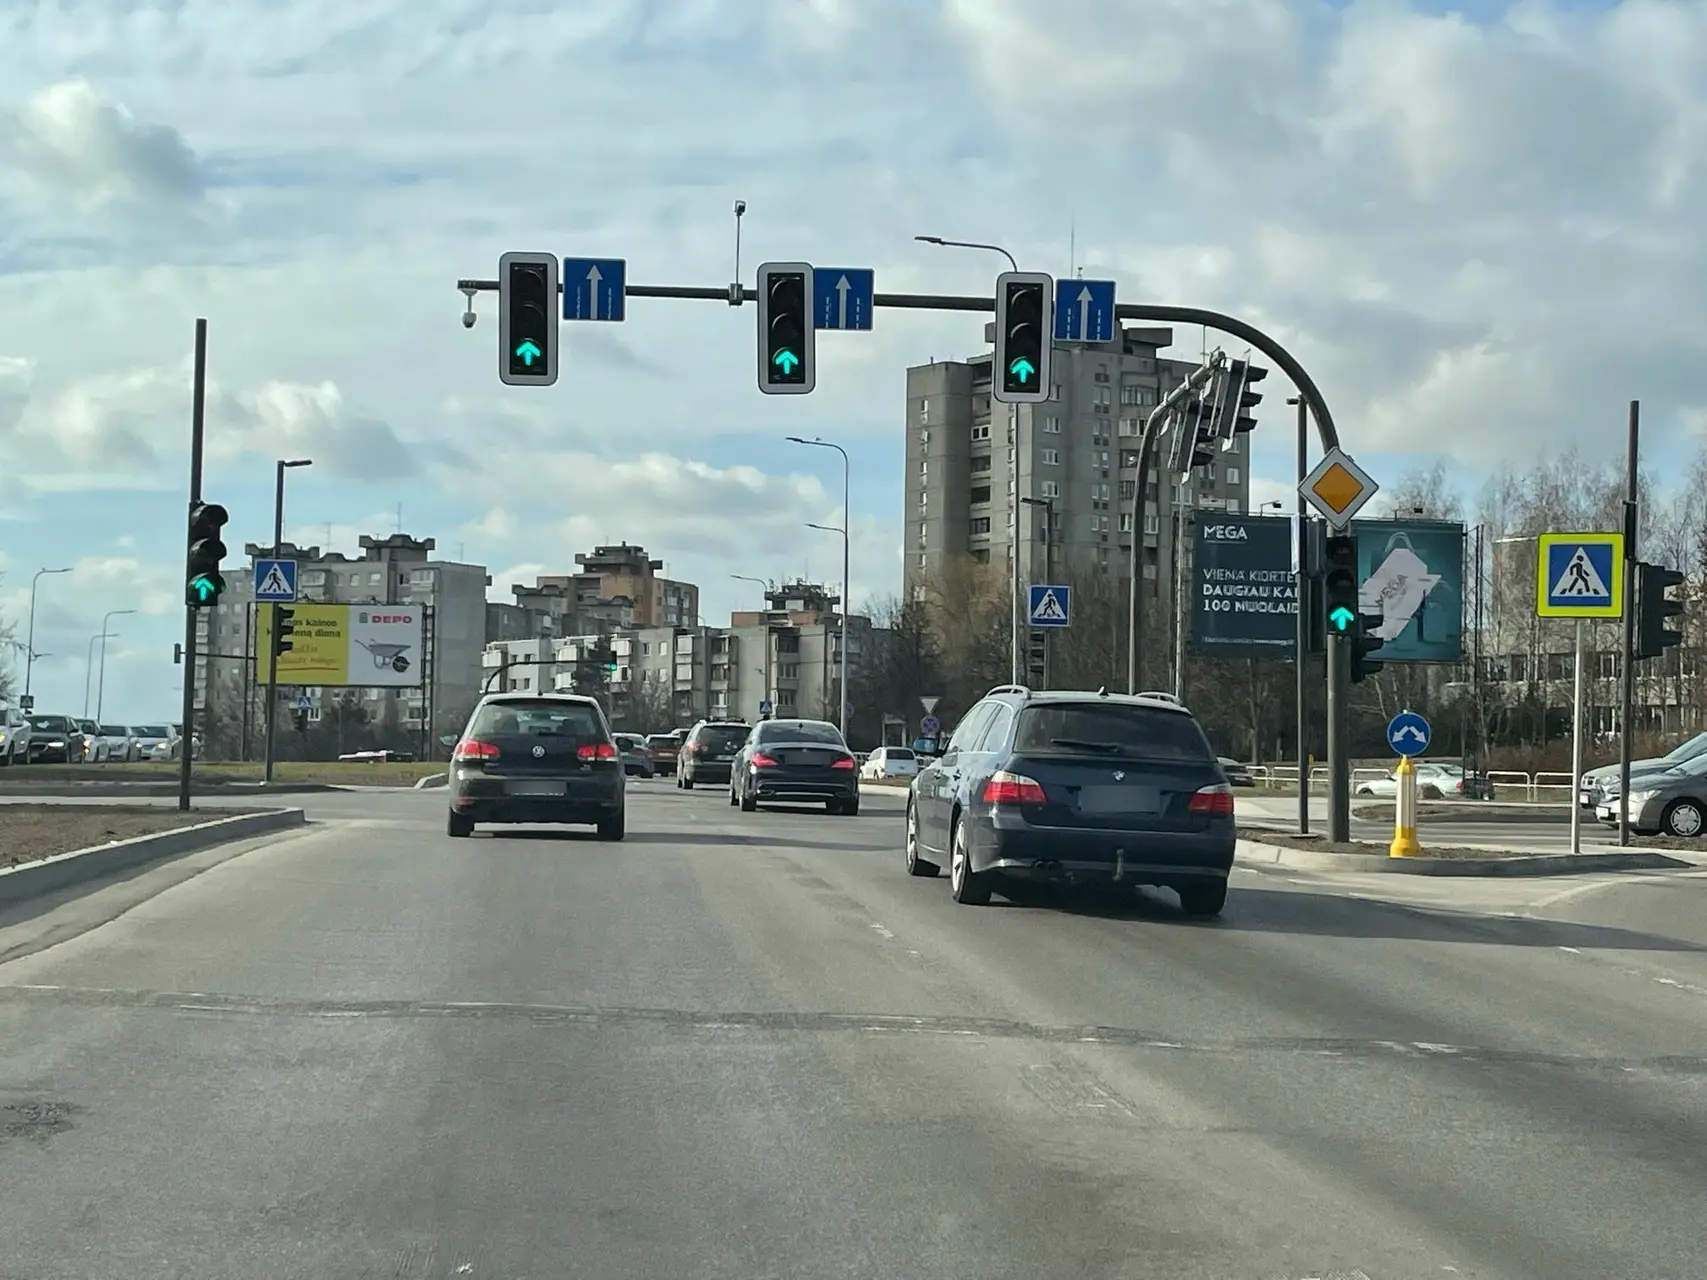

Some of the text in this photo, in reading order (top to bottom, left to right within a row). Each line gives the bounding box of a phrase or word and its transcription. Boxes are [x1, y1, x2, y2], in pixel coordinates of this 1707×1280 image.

[1203, 525, 1248, 540] MEGA
[1203, 568, 1295, 583] VIENA KORTE
[1203, 584, 1271, 598] DAUGIAU
[1203, 599, 1299, 614] 100 NUOLAID
[372, 615, 412, 624] DEPO
